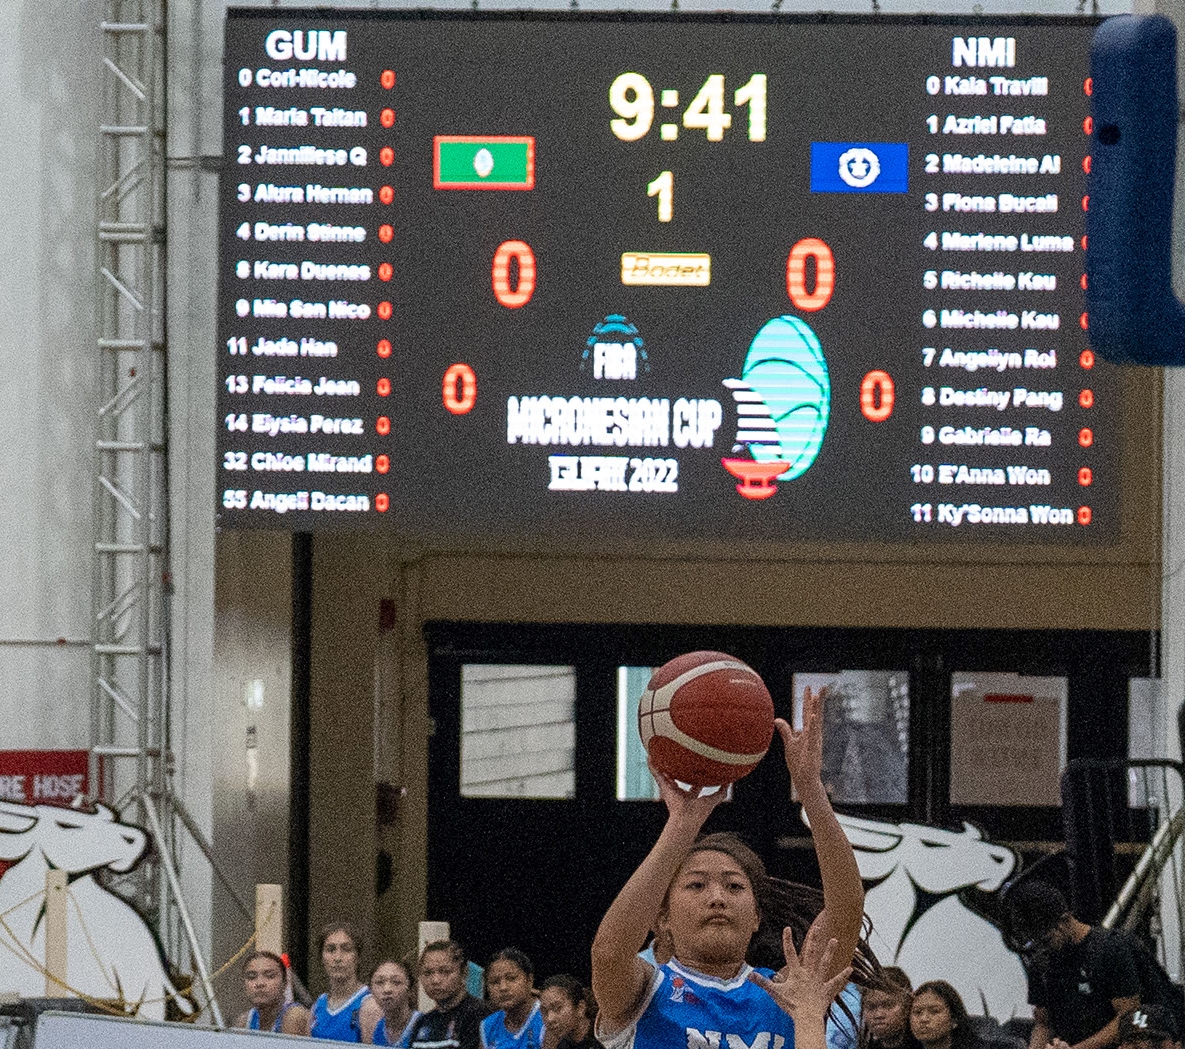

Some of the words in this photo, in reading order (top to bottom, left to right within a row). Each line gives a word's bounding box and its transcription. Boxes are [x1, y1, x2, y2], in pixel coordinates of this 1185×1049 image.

[265, 30, 347, 61] GUM
[952, 37, 1015, 67] NMI
[239, 68, 252, 87] 0
[926, 76, 940, 95] 0
[239, 107, 250, 125] 1
[609, 72, 767, 142] 9:41
[926, 115, 938, 134] 1
[238, 145, 252, 164] 2
[925, 154, 939, 173] 2
[238, 183, 251, 202] 3
[647, 171, 673, 222] 1
[925, 193, 938, 211] 3
[236, 222, 251, 240] 4
[923, 232, 938, 250] 4
[236, 261, 250, 279] 8
[492, 240, 536, 309] 0
[786, 238, 835, 312] 0
[924, 271, 937, 289] 5
[236, 299, 250, 317] 9
[922, 309, 937, 328] 6
[227, 337, 247, 355] 11
[922, 348, 936, 367] 7
[226, 375, 248, 394] 13
[442, 363, 477, 415] 0
[860, 370, 895, 422] 0
[921, 387, 935, 406] 8
[225, 414, 248, 432] 14
[672, 397, 722, 448] CUP
[921, 426, 935, 444] 9
[224, 452, 247, 470] 32
[910, 464, 934, 483] 10
[223, 490, 247, 509] 55
[911, 503, 932, 522] 11
[33, 773, 84, 799] HOSE
